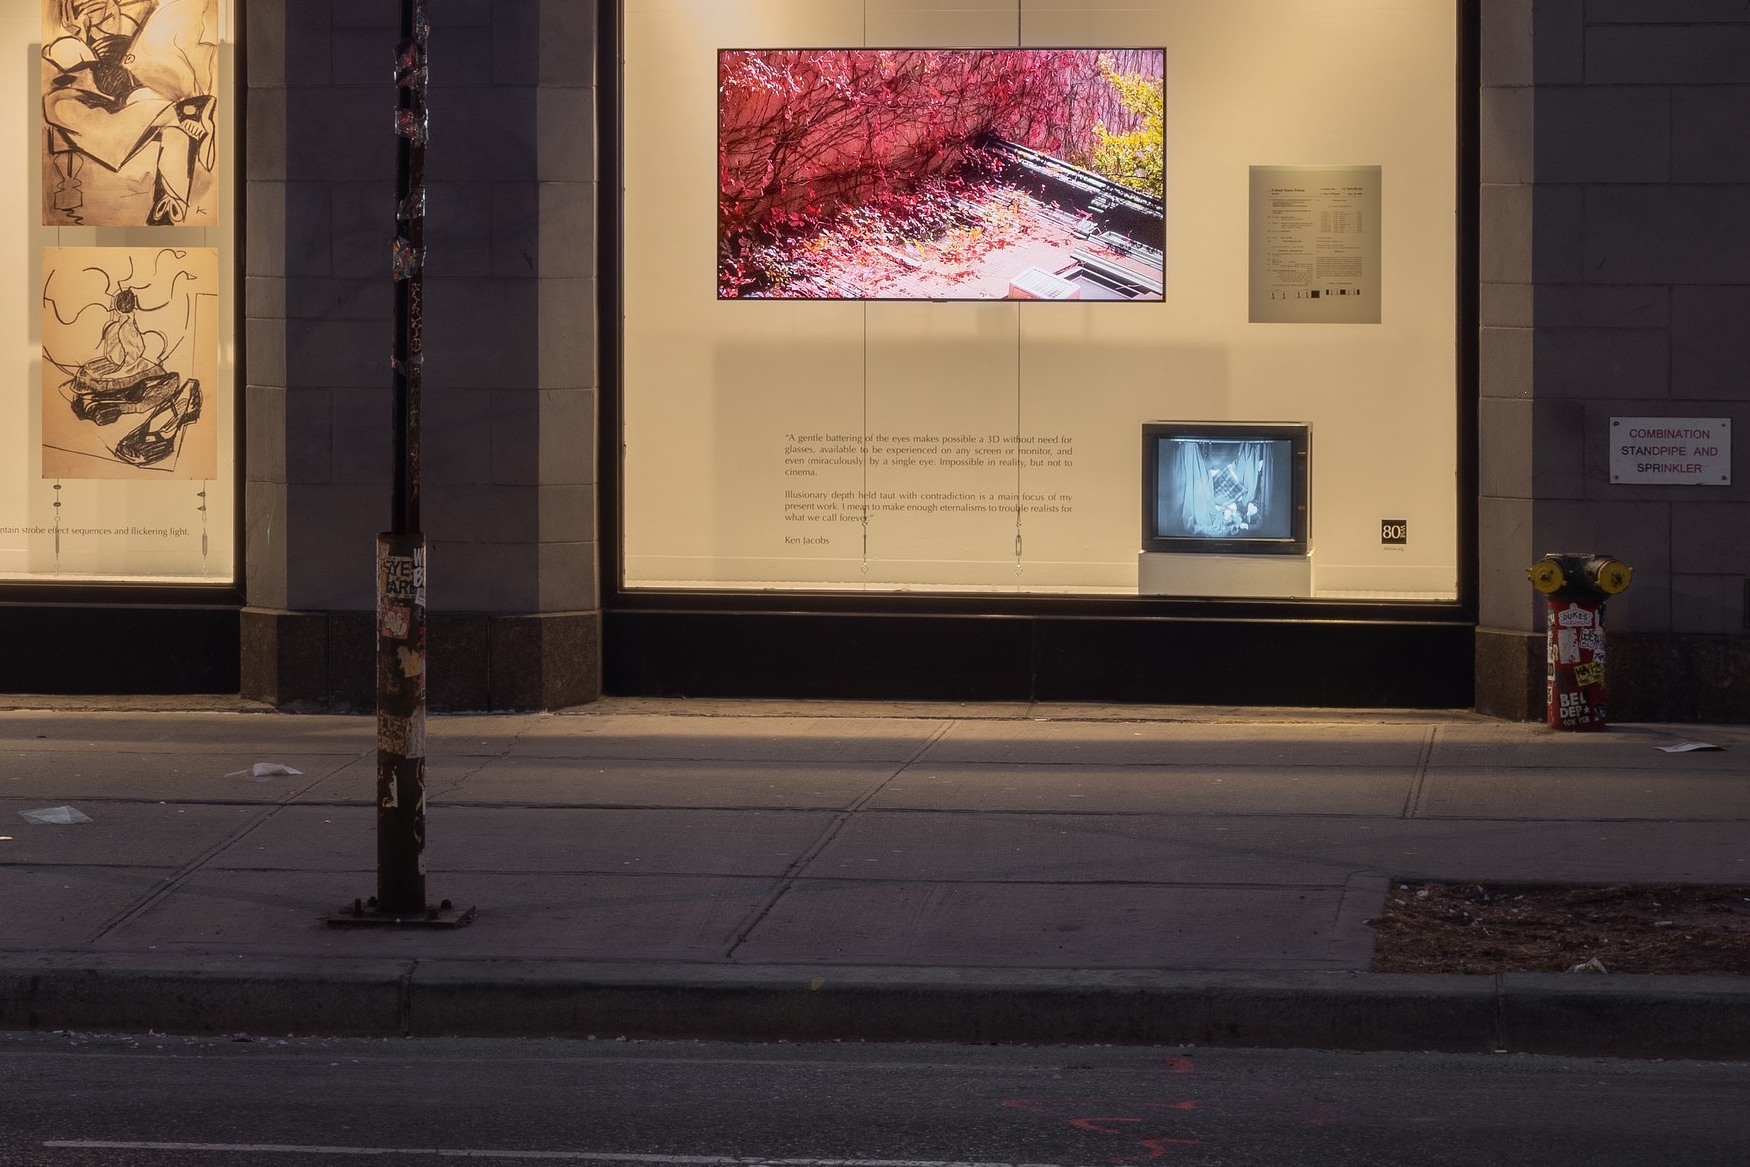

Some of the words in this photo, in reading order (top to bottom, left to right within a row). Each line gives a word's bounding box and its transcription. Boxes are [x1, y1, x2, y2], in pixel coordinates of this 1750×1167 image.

[798, 434, 823, 443] gentle
[826, 434, 863, 444] battering
[865, 434, 873, 442] of
[876, 434, 889, 442] the
[892, 436, 910, 444] eyes
[913, 434, 939, 442] makes
[942, 435, 976, 444] possible
[987, 435, 1000, 443] 3D
[1003, 435, 1034, 444] without
[1037, 435, 1059, 444] need
[1061, 435, 1073, 444] for
[1629, 429, 1710, 439] COMBINATION
[784, 445, 816, 455] glasses,
[819, 445, 856, 454] available
[860, 446, 869, 454] to
[872, 445, 883, 454] be
[886, 445, 937, 456] experienced
[955, 448, 971, 457] any
[1018, 447, 1053, 456] monitor,
[1056, 447, 1073, 456] and
[1621, 446, 1686, 456] STANDPIPE
[1694, 447, 1719, 456] AND
[869, 457, 880, 466] by
[891, 457, 916, 467] single
[919, 459, 936, 467] eye.
[940, 458, 984, 468] Impossible
[987, 458, 995, 466] in
[999, 458, 1026, 468] reality,
[1030, 458, 1044, 467] but
[1047, 459, 1061, 467] not
[1064, 459, 1073, 467] to
[784, 468, 818, 476] cinema.
[1637, 463, 1702, 473] SPRINKLER
[785, 513, 805, 522] what
[821, 513, 837, 522] call
[21, 526, 46, 534] strobe
[47, 526, 69, 534] effect
[71, 528, 112, 536] sequences
[113, 527, 129, 535] and
[131, 527, 168, 537] flickering
[170, 527, 190, 537] light.
[1383, 525, 1401, 539] 80
[785, 536, 800, 544] Ken
[803, 536, 830, 545] Jacobs
[1563, 612, 1588, 620] DUKES
